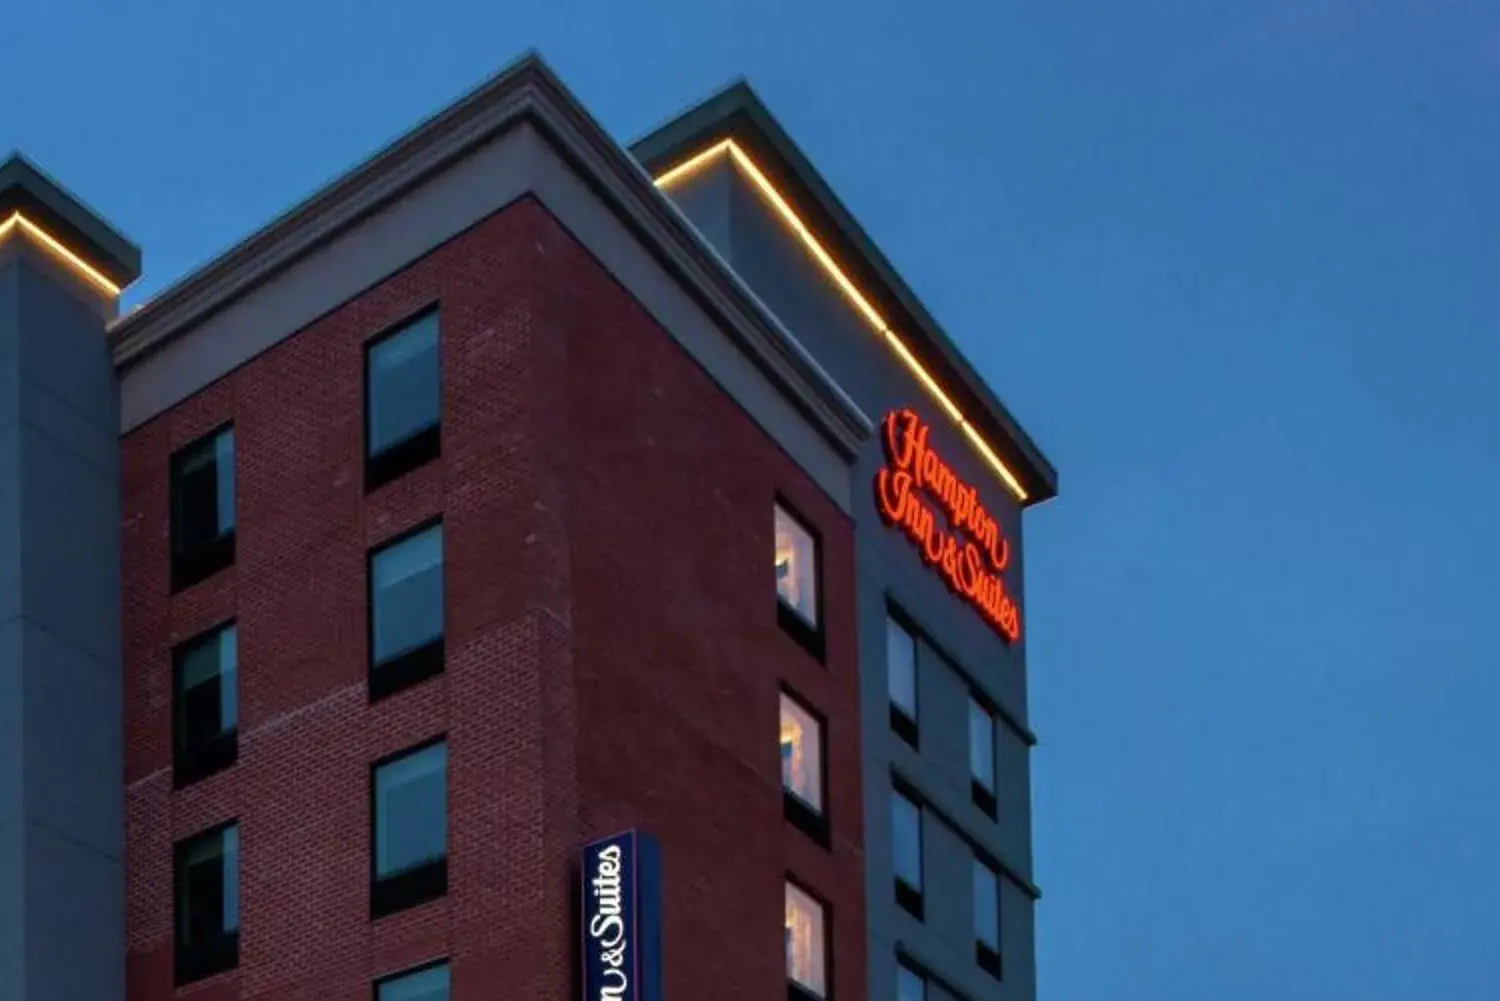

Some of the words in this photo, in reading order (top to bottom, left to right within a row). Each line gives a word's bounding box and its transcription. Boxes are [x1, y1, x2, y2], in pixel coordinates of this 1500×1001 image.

[878, 467, 944, 563] Inn
[941, 534, 963, 592] &
[957, 542, 1020, 642] Suites
[884, 408, 1009, 569] Hampton
[590, 843, 624, 948] Suites
[600, 939, 627, 967] &
